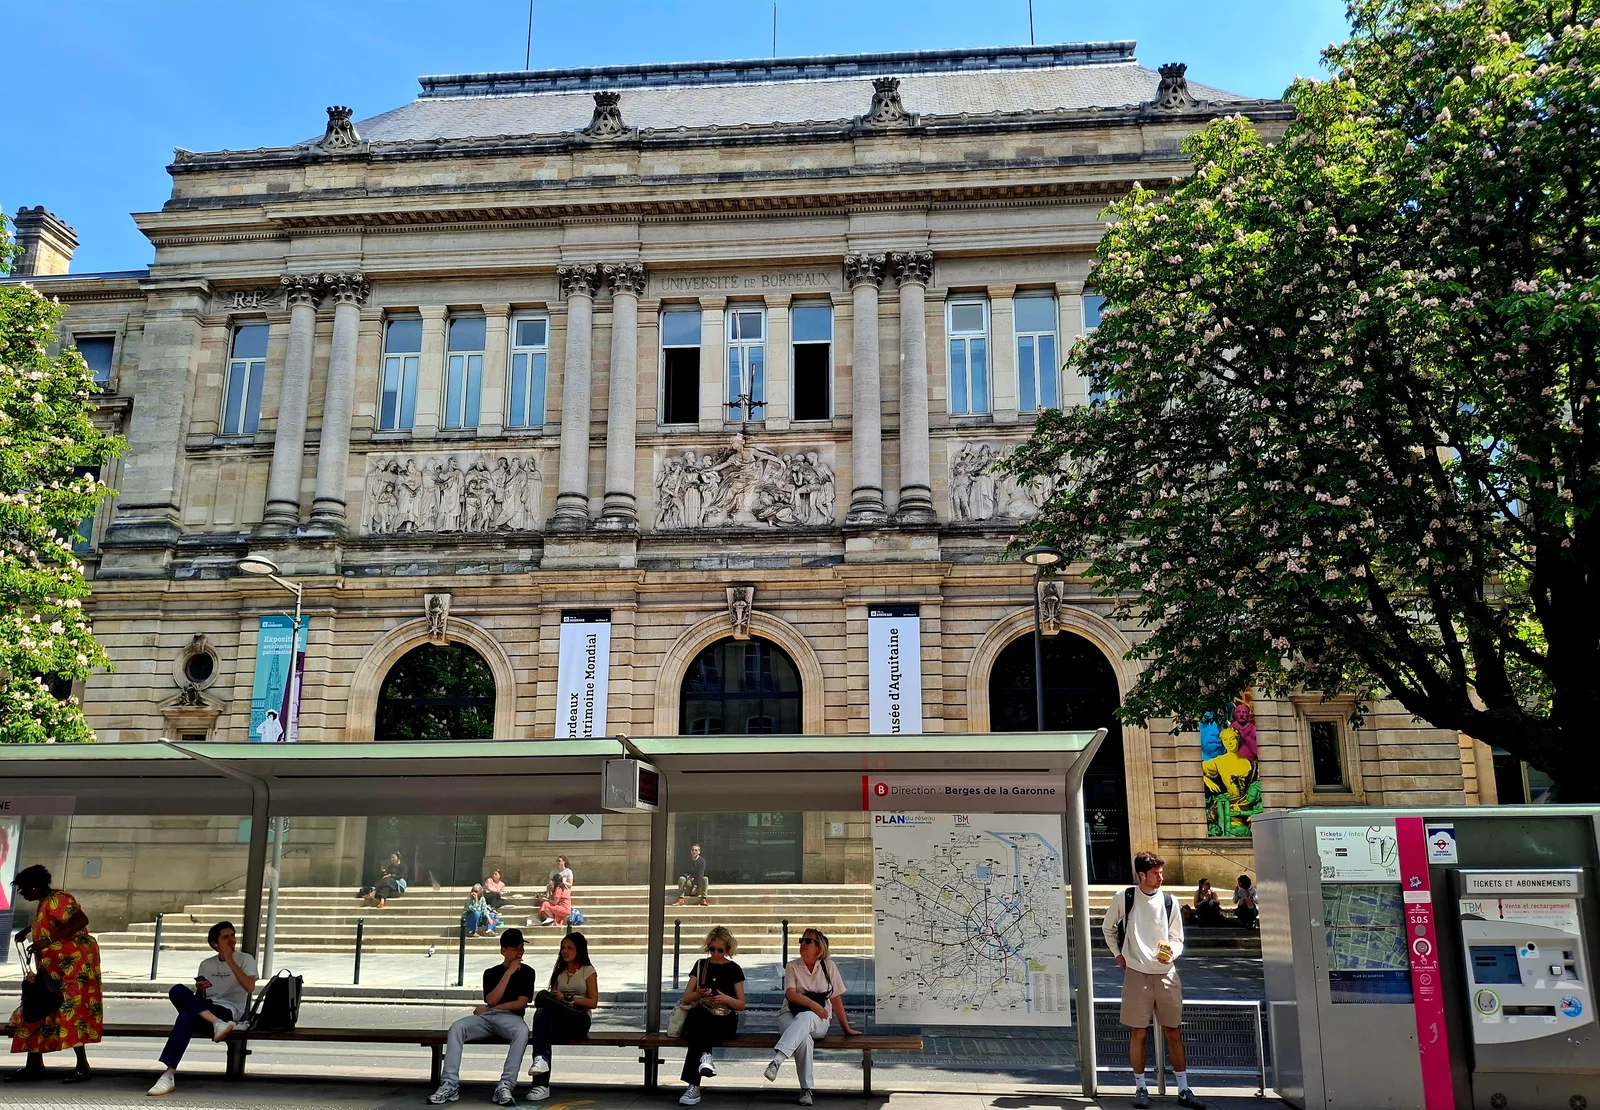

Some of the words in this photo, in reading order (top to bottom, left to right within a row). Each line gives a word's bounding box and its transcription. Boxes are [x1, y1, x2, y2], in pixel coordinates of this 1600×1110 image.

[661, 275, 739, 291] UNIVERSITÉ
[744, 278, 756, 288] DE
[761, 272, 831, 288] BORDEAUX
[585, 633, 597, 680] Mondial
[888, 628, 902, 700] d'Aquitaine
[567, 693, 579, 738] ordeaux
[582, 683, 595, 738] atrimoine
[889, 703, 901, 734] usée
[891, 786, 936, 795] Direction
[945, 786, 982, 797] Berges
[983, 786, 996, 795] de
[999, 786, 1008, 795] la
[1012, 786, 1056, 795] Garonne
[875, 815, 905, 824] PLAN
[952, 815, 970, 825] TBM
[1473, 880, 1502, 888] TICKETS
[1462, 903, 1484, 914] TBM
